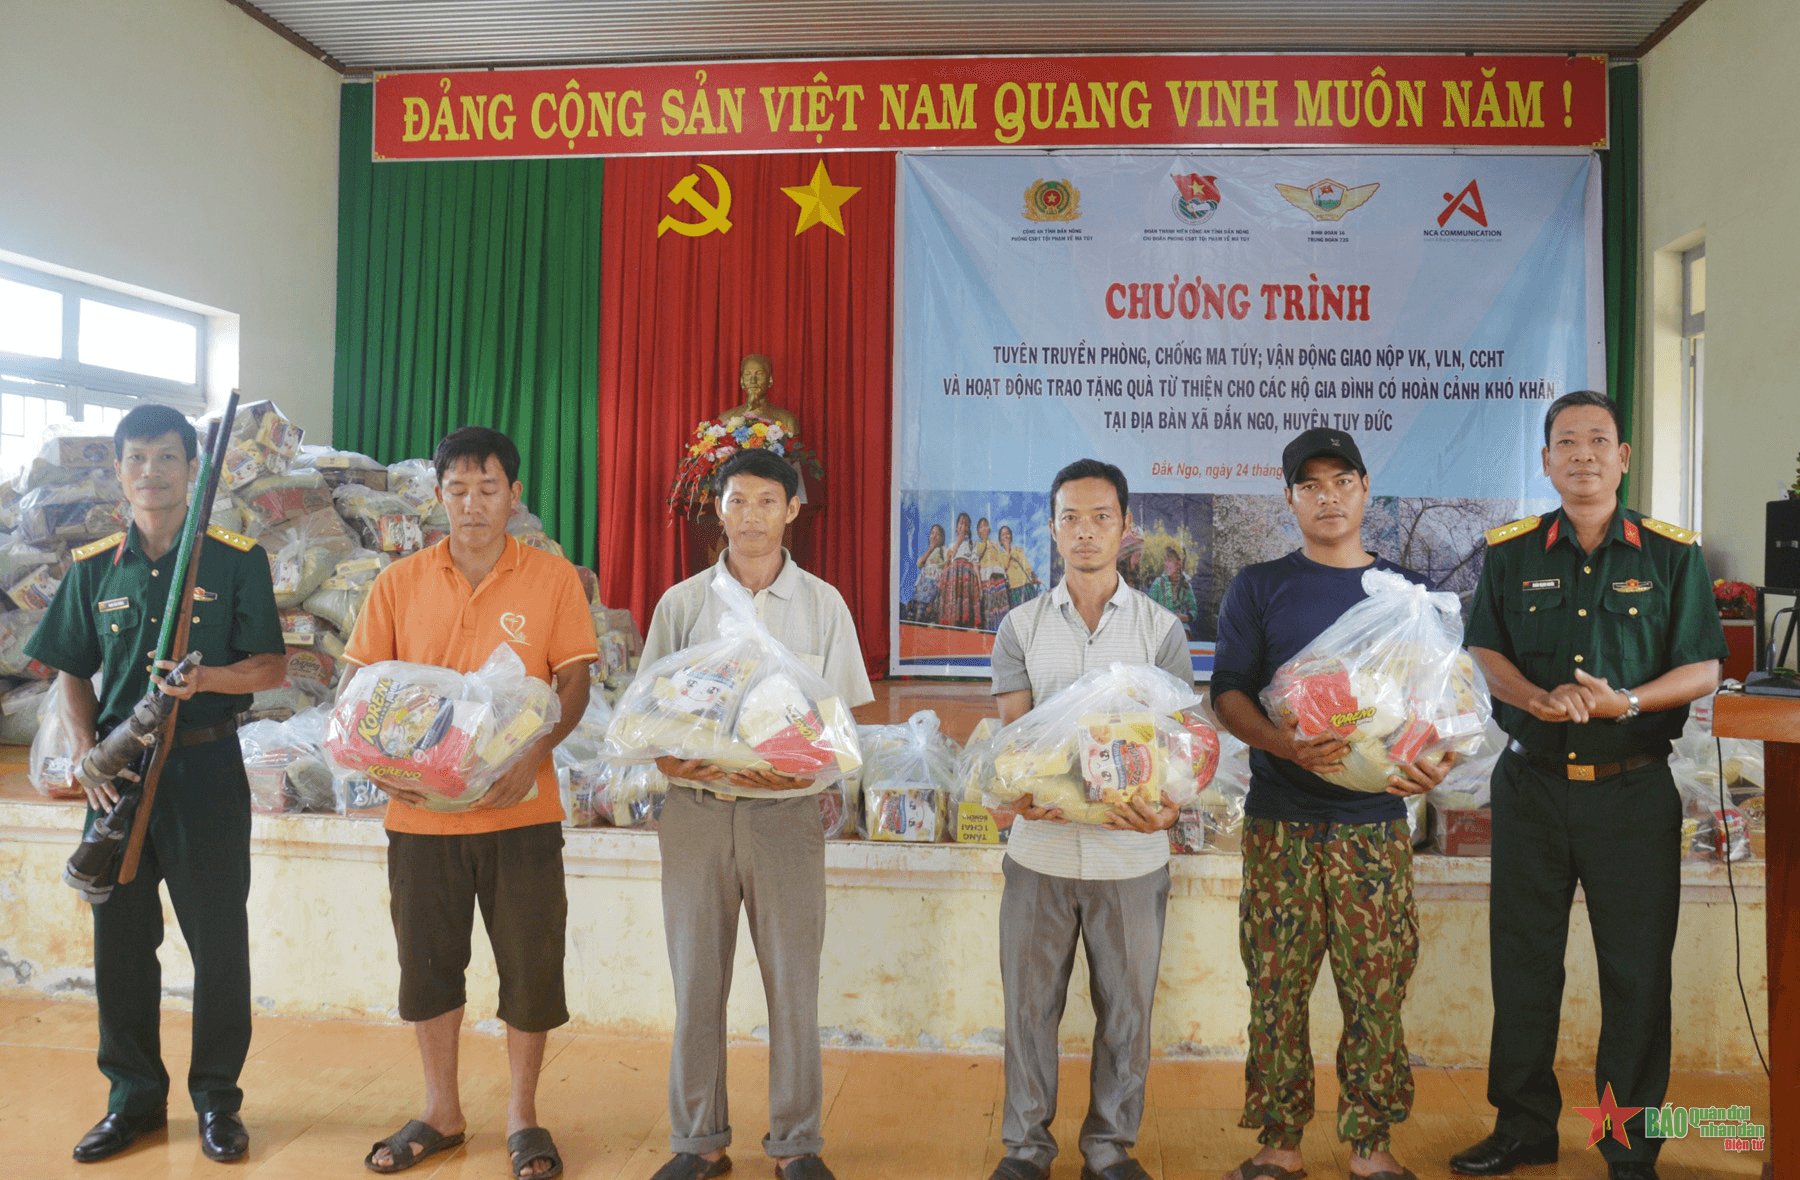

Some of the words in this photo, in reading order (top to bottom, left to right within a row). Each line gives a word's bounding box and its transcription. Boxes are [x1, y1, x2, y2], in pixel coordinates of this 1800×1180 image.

[403, 77, 516, 142] ĐẢNG
[531, 78, 646, 149] CỘNG
[661, 69, 746, 136] SẢN
[760, 71, 865, 143] VIỆT
[879, 83, 977, 130] NAM
[994, 80, 1152, 143] QUANG
[1165, 80, 1283, 127] VINH
[1295, 66, 1426, 128] MUÔN
[1442, 67, 1545, 128] NĂM
[1563, 80, 1573, 127] !
[1105, 274, 1251, 320] CHƯƠNG
[1260, 273, 1371, 321] TRÌNH
[993, 342, 1037, 364] TUYÊN
[1042, 339, 1095, 365] TRUYỀN
[1101, 342, 1150, 368] PHÒNG,
[1155, 340, 1201, 365] CHỐNG
[1206, 347, 1226, 365] MA
[1231, 342, 1262, 368] TÚY;
[1267, 343, 1294, 369] VẬN
[1299, 343, 1336, 369] ĐỘNG
[1341, 348, 1371, 367] GIAO
[1376, 344, 1404, 370] NỘP
[1408, 349, 1430, 370] VK,
[1435, 350, 1464, 370] VLN,
[1469, 350, 1504, 368] CCHT
[943, 374, 960, 395] VÀ
[966, 378, 1000, 398] HOẠT
[1005, 374, 1042, 399] ĐỘNG
[1047, 379, 1082, 396] TRAO
[1087, 376, 1122, 401] TẶNG
[1127, 376, 1153, 399] QUÀ
[1159, 375, 1178, 396] TỪ
[1182, 376, 1222, 401] THIỆN
[1227, 380, 1254, 397] CHO
[1259, 376, 1286, 398] CÁC
[1291, 376, 1309, 401] HỘ
[1314, 381, 1336, 398] GIA
[1341, 376, 1373, 398] ĐÌNH
[1379, 377, 1396, 399] CÓ
[1401, 377, 1438, 399] HOÀN
[1443, 375, 1479, 400] CẢNH
[1485, 377, 1513, 399] KHÓ
[1519, 377, 1555, 400] KHĂN
[1104, 411, 1126, 433] TẠI
[1131, 411, 1153, 433] ĐỊA
[1159, 407, 1186, 429] BÀN
[1191, 408, 1208, 429] XÃ
[1214, 404, 1242, 430] ĐẮK
[1247, 412, 1278, 433] NGO,
[1334, 413, 1359, 431] TUY
[1365, 409, 1393, 431] ĐỨC
[1152, 460, 1173, 475] Đắk
[1177, 463, 1202, 478] Ngo,
[1206, 463, 1233, 479] ngày
[1236, 463, 1248, 476] 24
[1252, 463, 1283, 480] tháng
[1331, 706, 1377, 728] KORENO
[368, 764, 422, 780] KORENO
